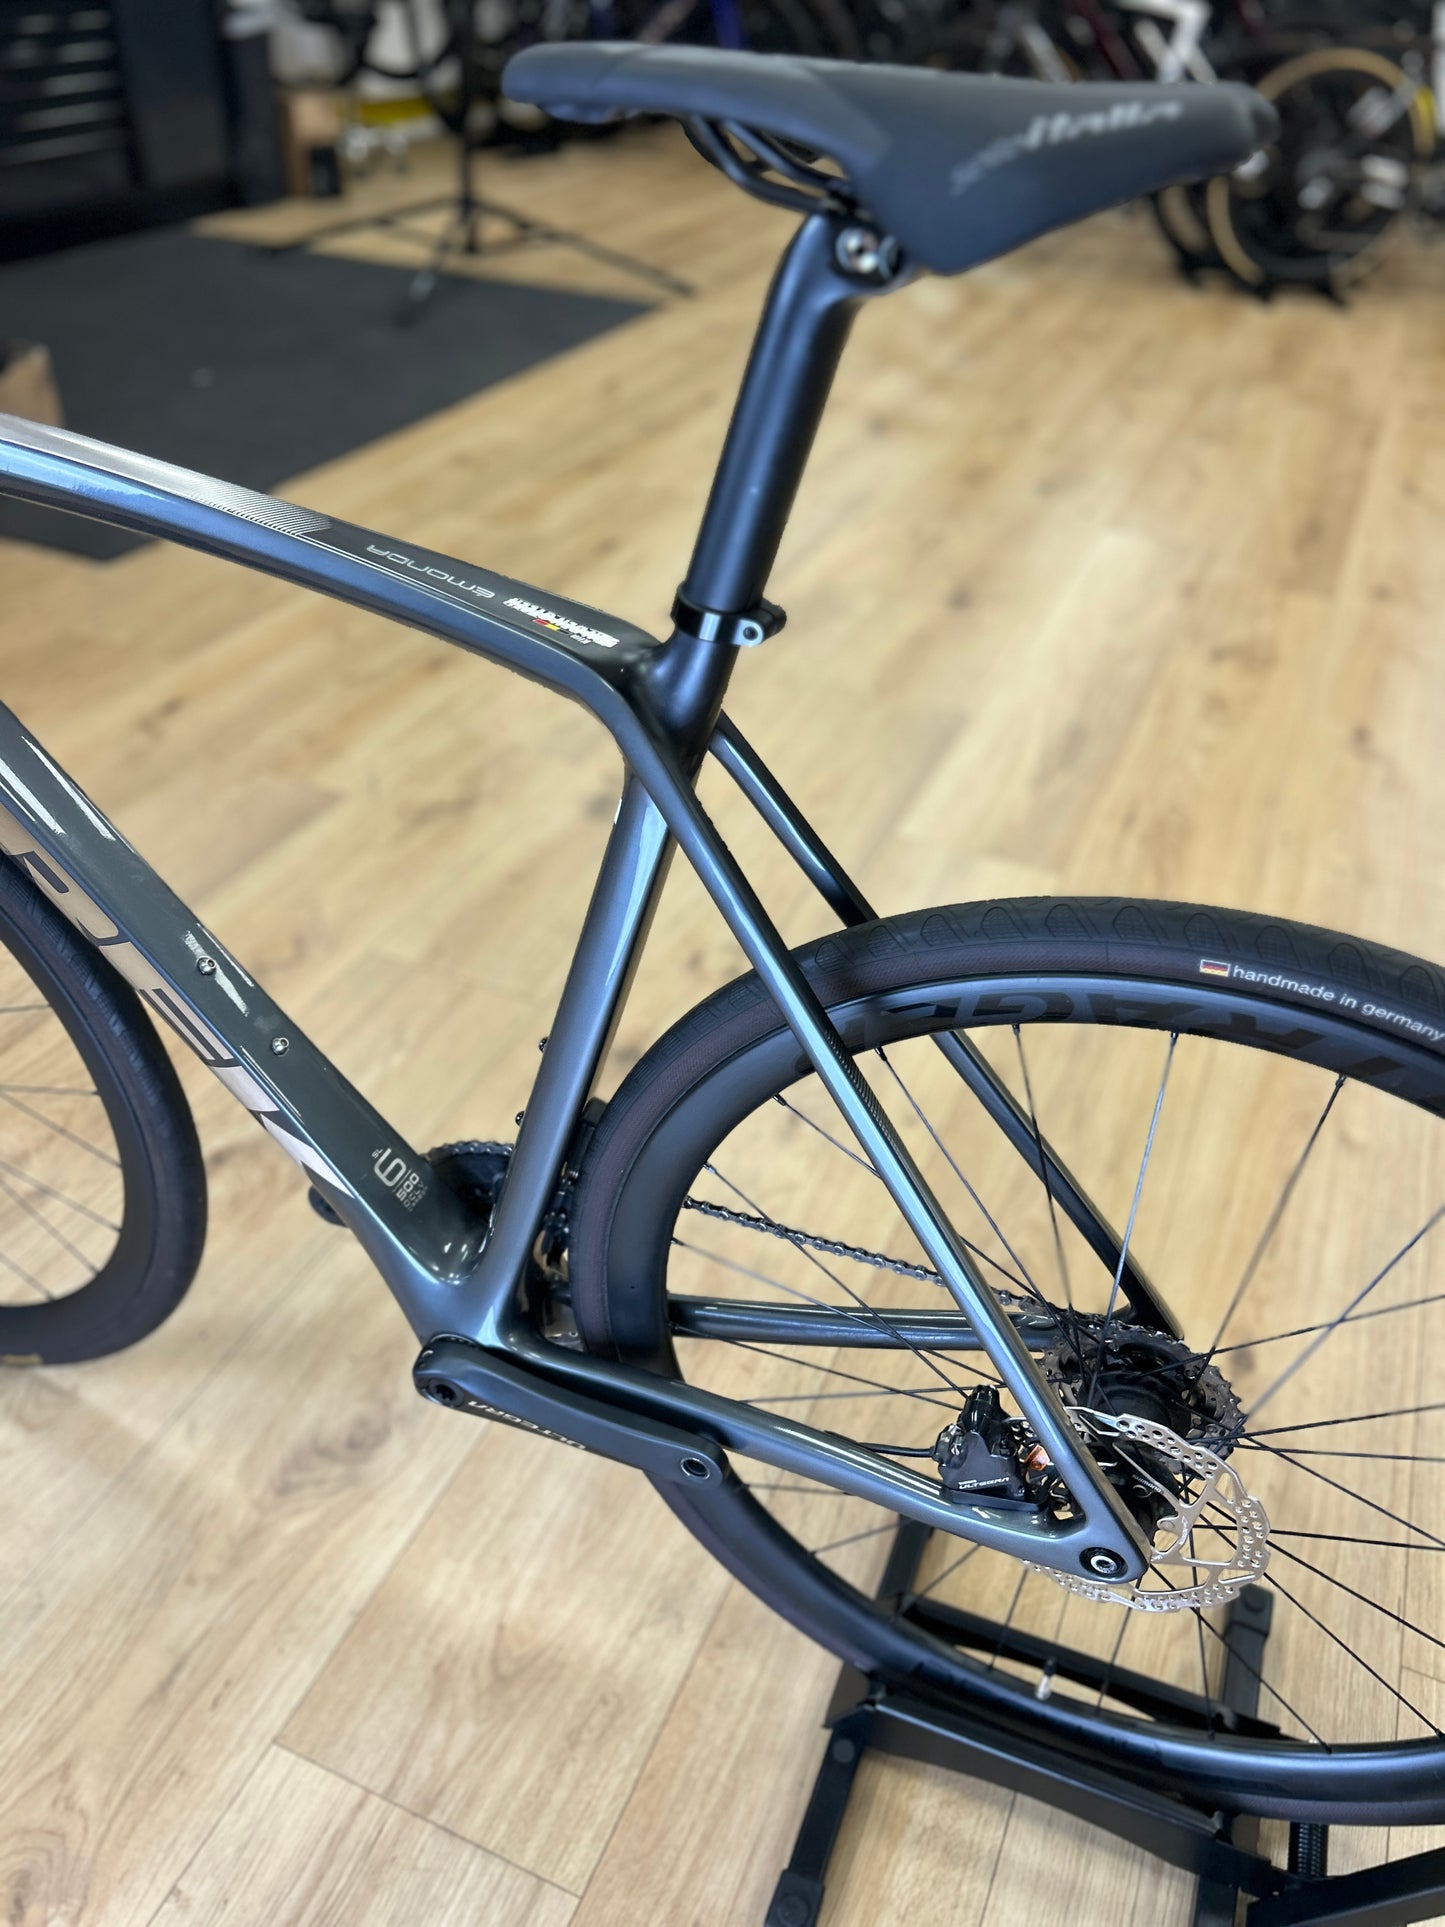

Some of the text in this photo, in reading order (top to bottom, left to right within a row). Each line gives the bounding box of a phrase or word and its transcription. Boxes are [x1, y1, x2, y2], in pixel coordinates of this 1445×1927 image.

[0, 802, 356, 1199] REK
[1233, 963, 1445, 1042] handmade in germany
[374, 1147, 407, 1187] 6
[396, 1172, 420, 1201] 500
